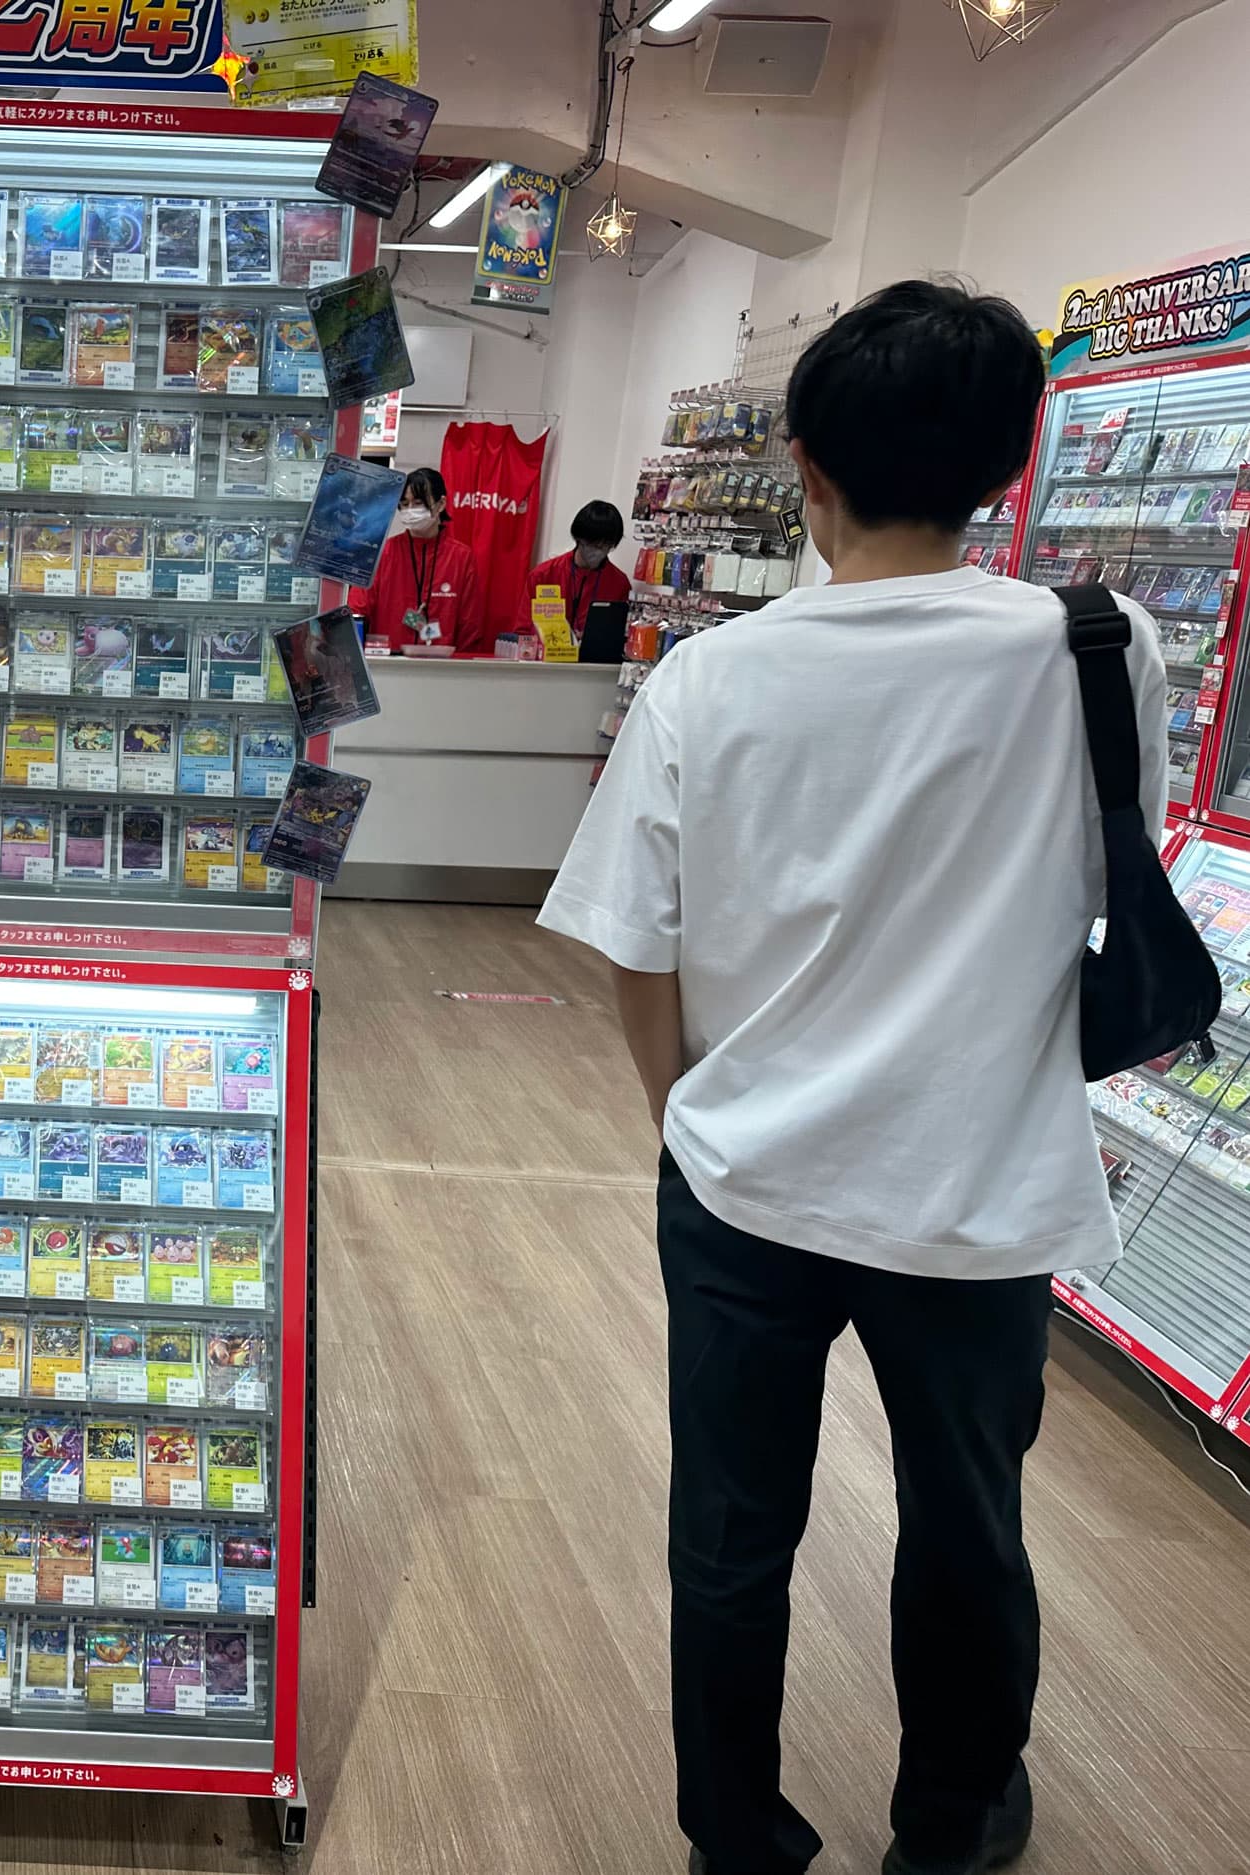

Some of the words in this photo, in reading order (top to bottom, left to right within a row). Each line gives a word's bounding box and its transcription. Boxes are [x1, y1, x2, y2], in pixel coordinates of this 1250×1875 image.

[1066, 296, 1104, 329] 2nd
[1093, 325, 1129, 355] BIG
[1133, 302, 1232, 347] THANKS!
